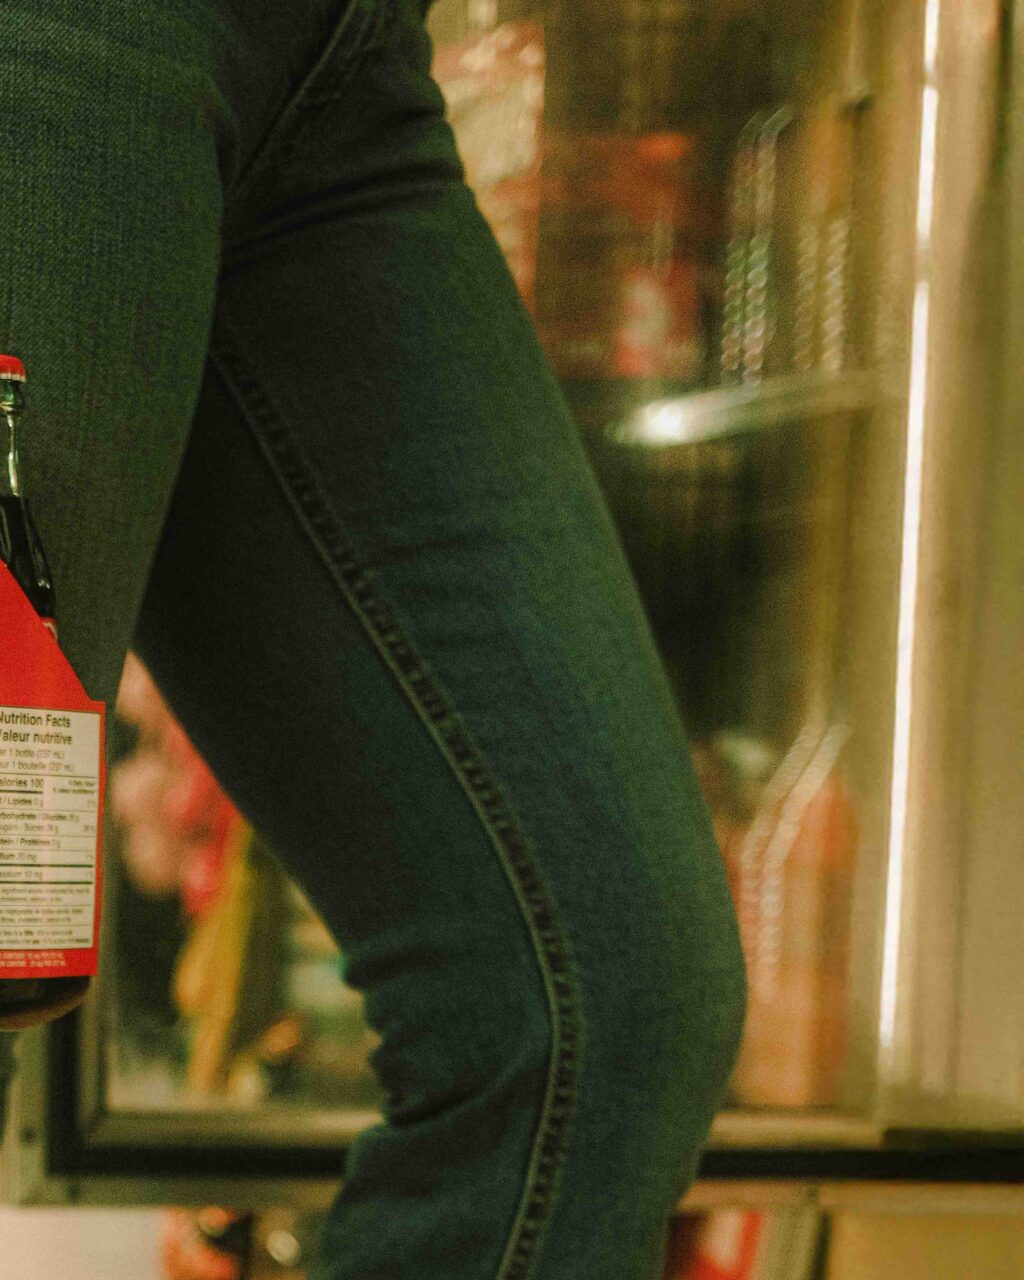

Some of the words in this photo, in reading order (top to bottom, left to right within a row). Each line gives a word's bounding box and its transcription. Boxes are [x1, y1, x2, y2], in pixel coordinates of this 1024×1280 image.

[45, 714, 71, 728] Facts
[33, 731, 73, 746] nutritive
[15, 748, 35, 759] bottle
[7, 797, 32, 807] Lipides
